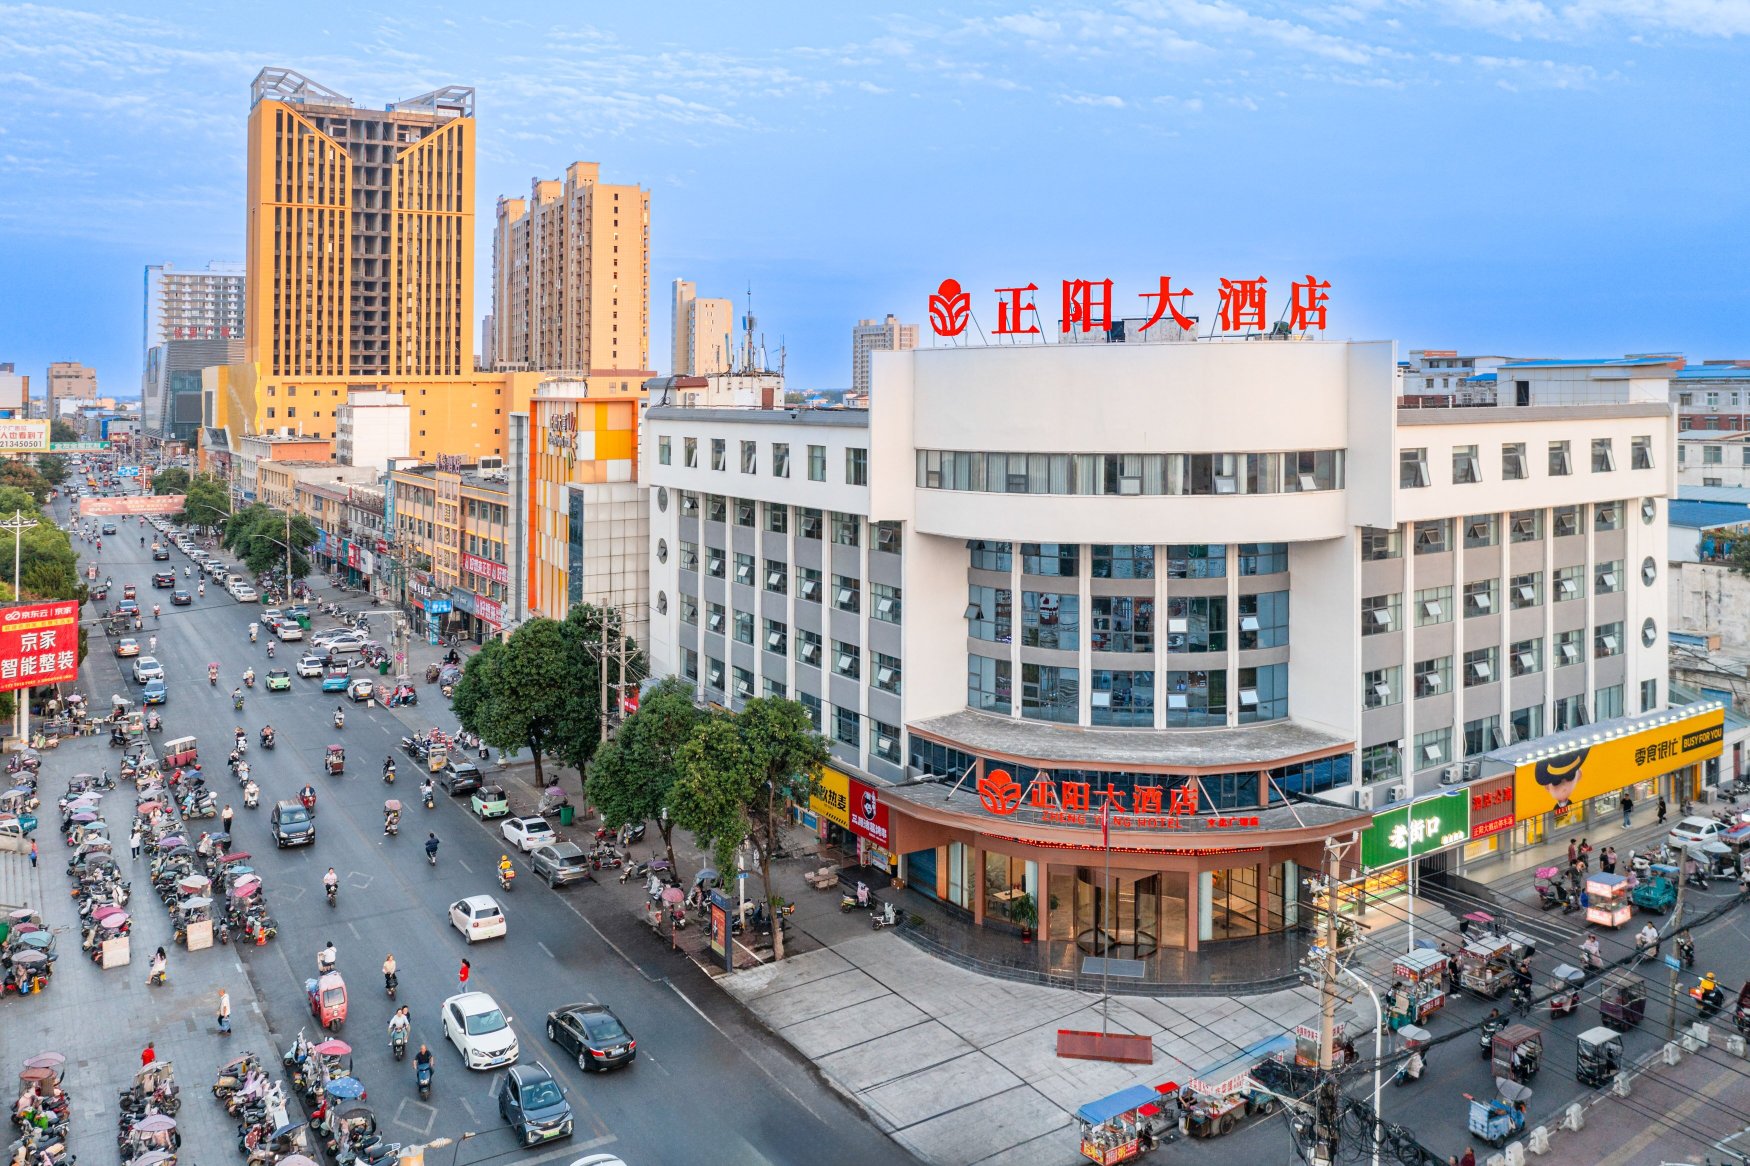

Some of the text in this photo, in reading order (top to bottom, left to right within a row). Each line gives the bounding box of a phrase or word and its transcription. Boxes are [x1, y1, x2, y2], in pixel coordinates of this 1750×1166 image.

[991, 275, 1332, 334] 正阳大酒店
[21, 606, 72, 619] 京东云 京家
[20, 630, 57, 653] 京家
[1, 650, 74, 679] 智能整装
[1683, 727, 1723, 748] BUSY FOR YOU
[1634, 738, 1679, 767] 零食很忙
[1030, 780, 1199, 816] 正阳大酒店
[1041, 810, 1182, 829] ZHENG YNG HOTEL
